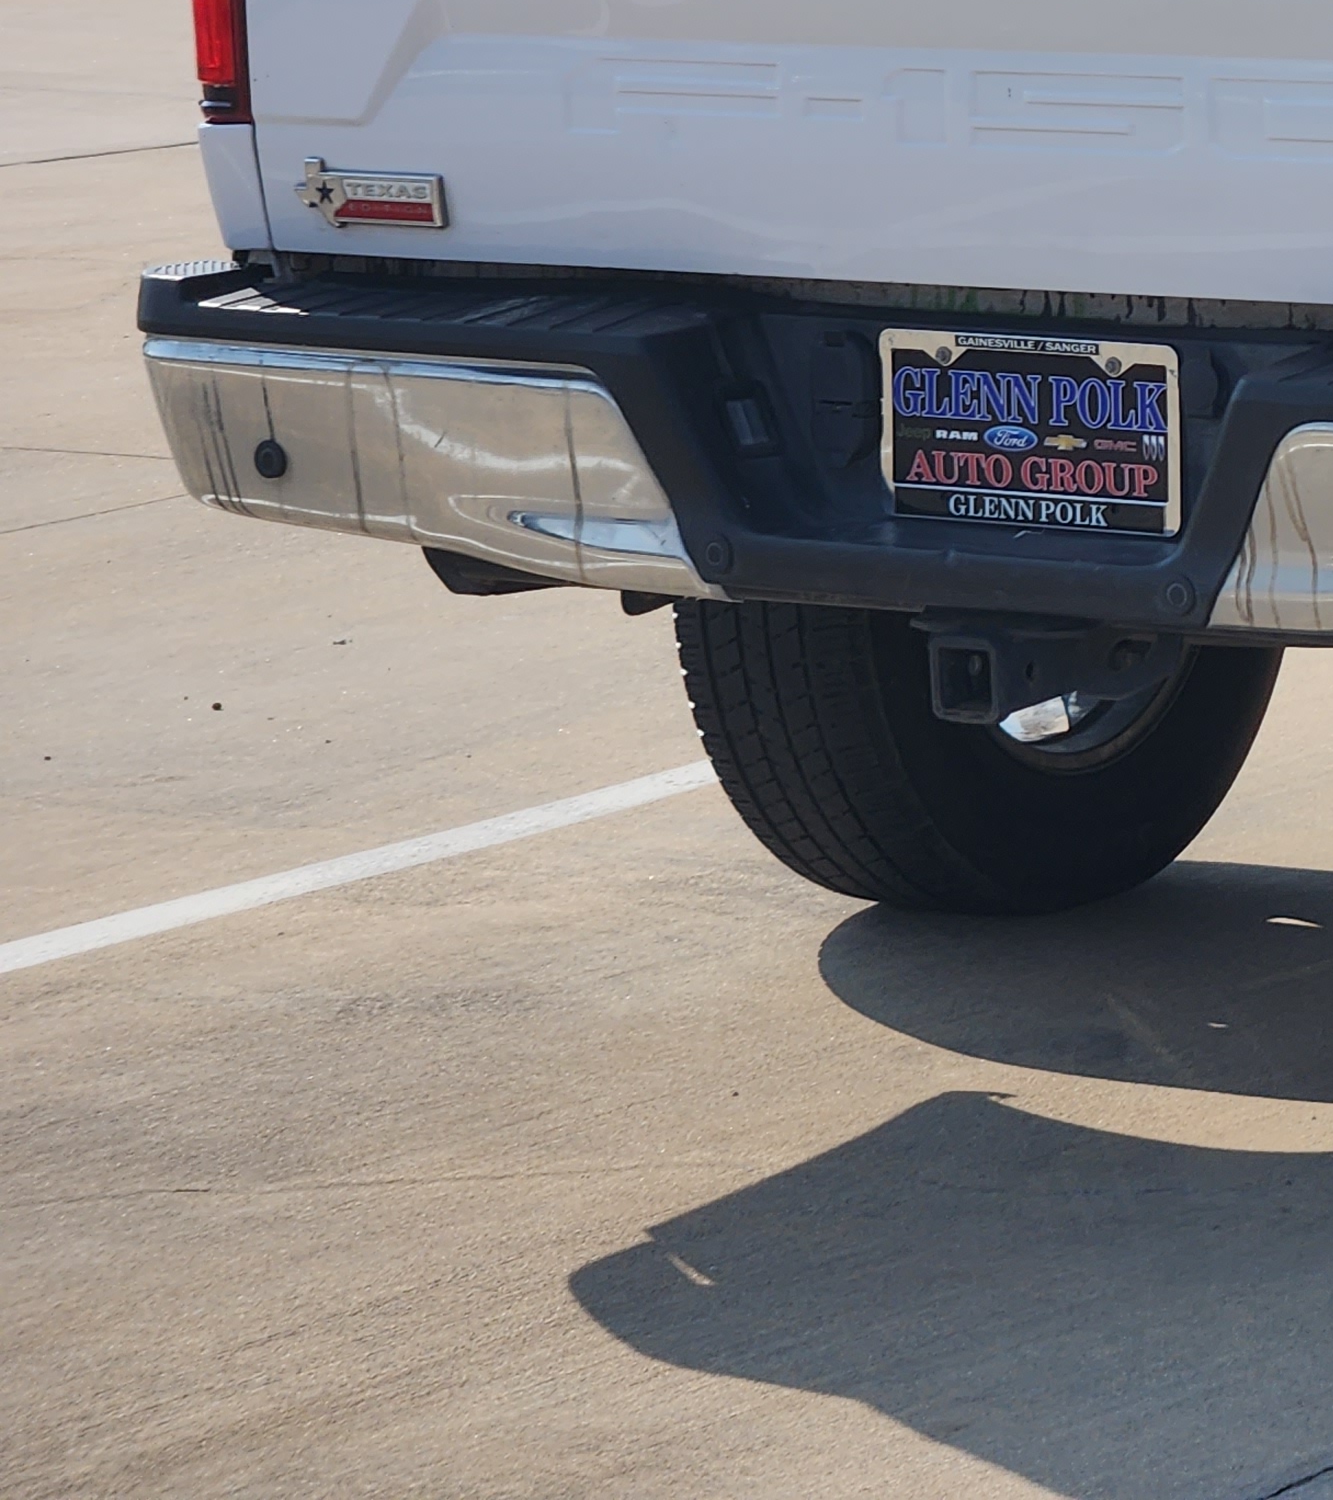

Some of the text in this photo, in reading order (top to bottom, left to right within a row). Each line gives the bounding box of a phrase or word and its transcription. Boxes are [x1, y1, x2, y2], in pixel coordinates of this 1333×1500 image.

[345, 182, 429, 200] TEXAS
[957, 336, 1036, 350] GAINESVILLE
[1045, 342, 1096, 354] SANGER
[893, 365, 1168, 432] GLENN POLK
[935, 429, 979, 441] RAM
[993, 429, 1030, 449] Ford
[906, 449, 1158, 498] AUTO GROUP
[949, 494, 1108, 527] GLENN POLK
